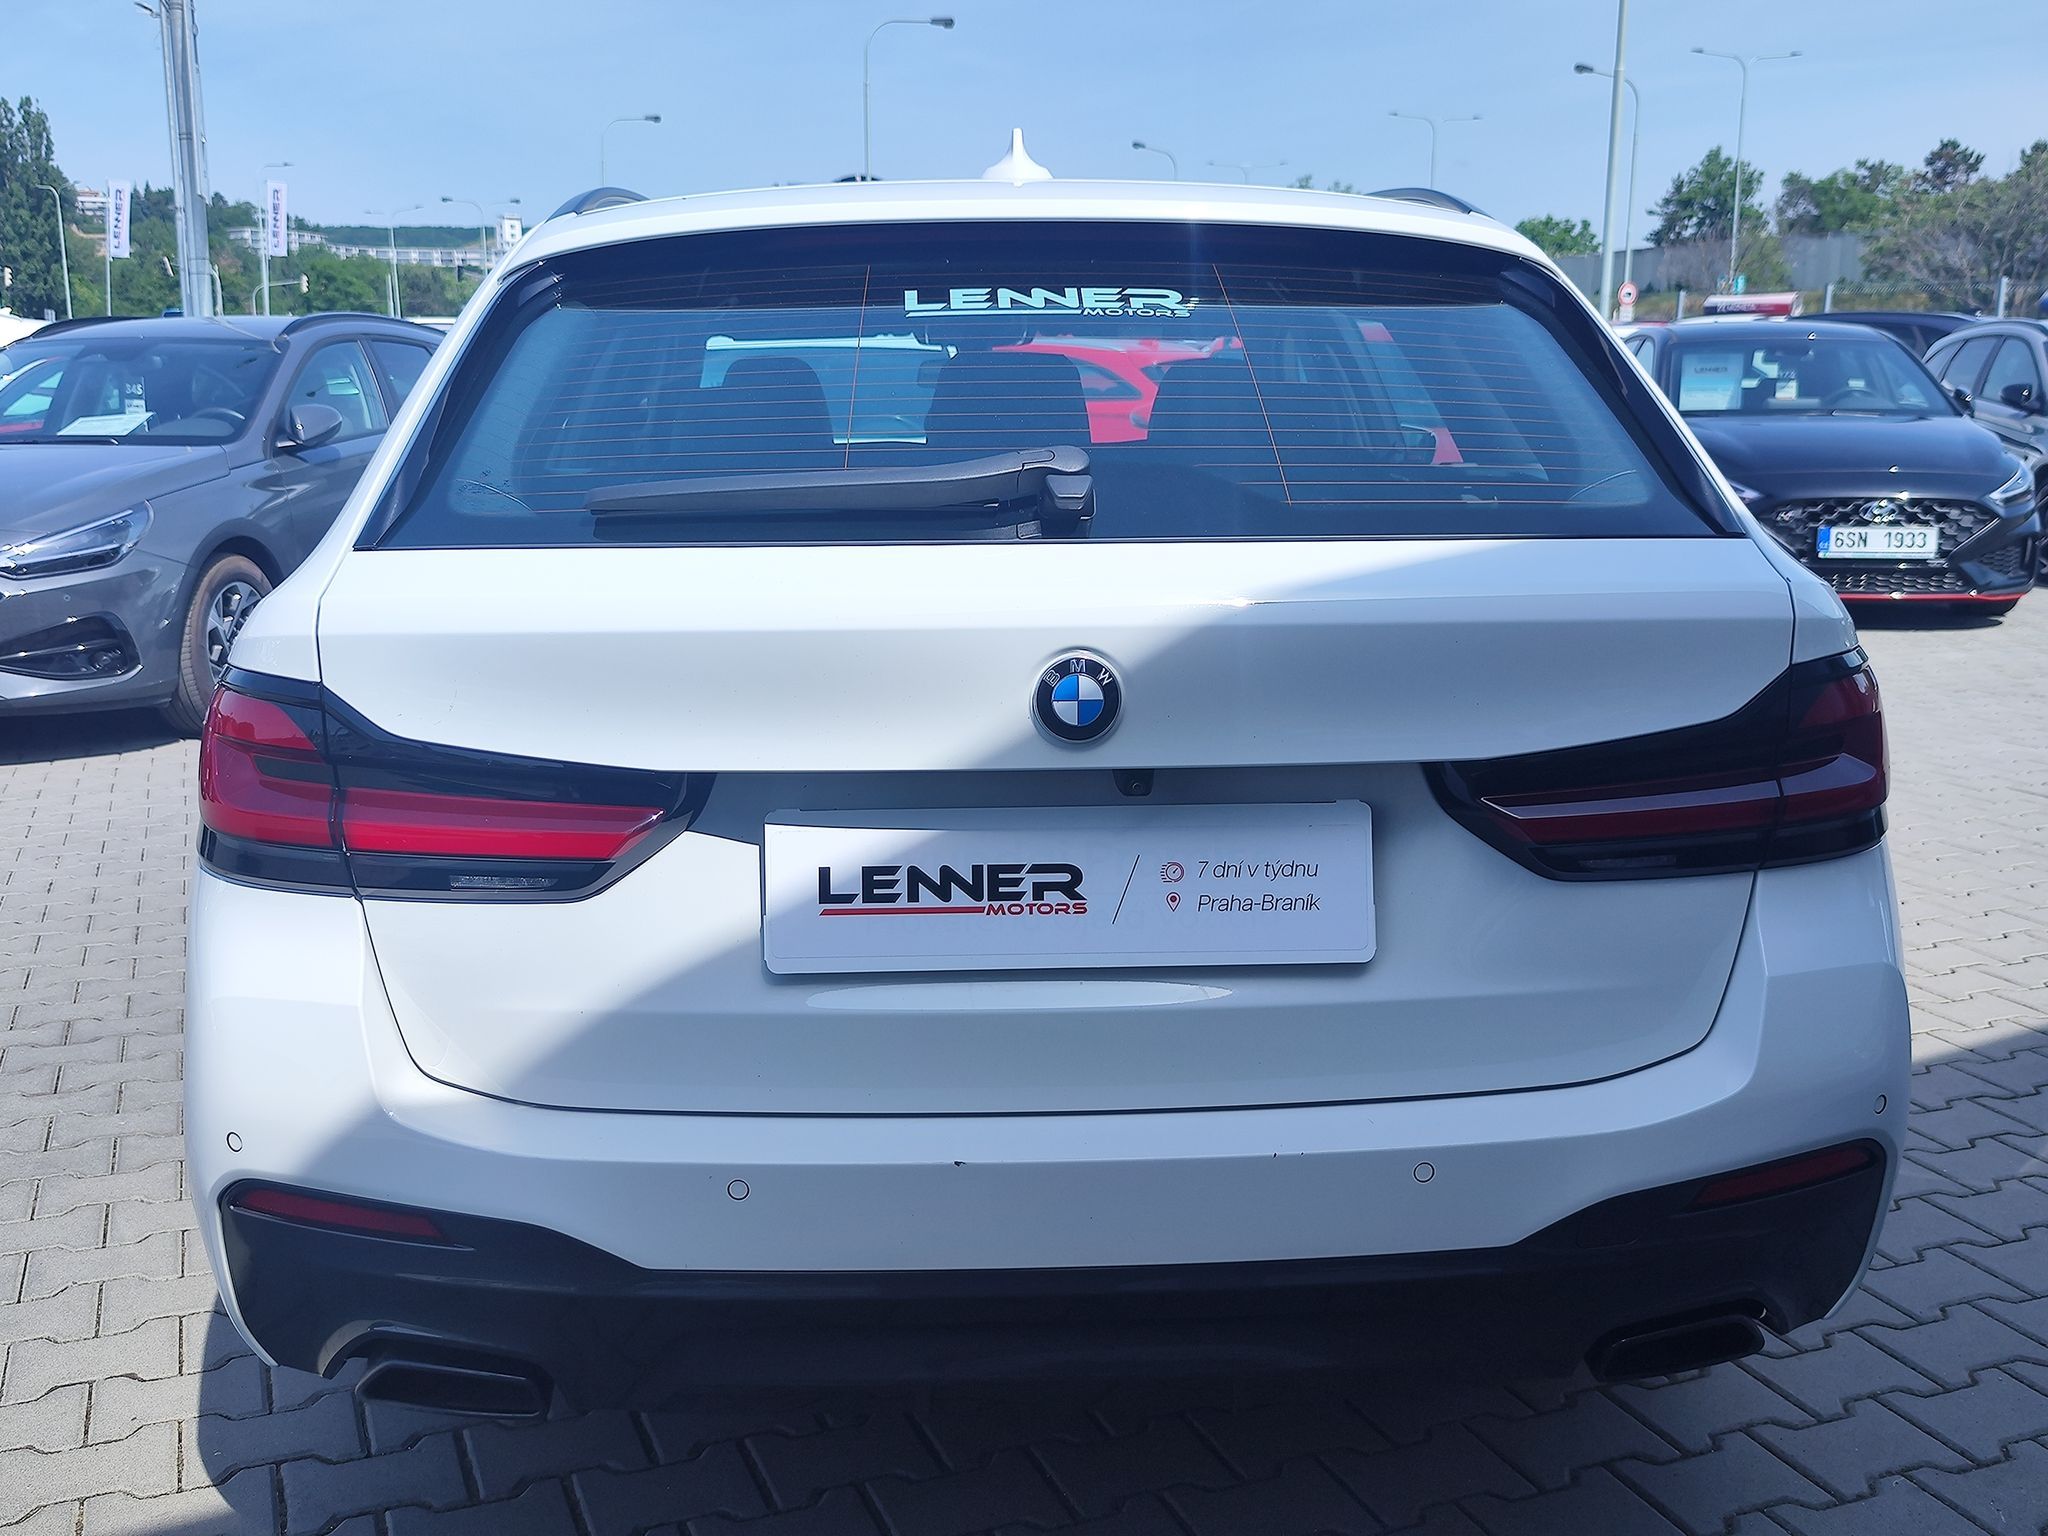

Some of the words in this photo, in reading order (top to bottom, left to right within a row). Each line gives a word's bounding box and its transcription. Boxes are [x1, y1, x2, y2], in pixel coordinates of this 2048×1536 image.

[904, 287, 1188, 311] LENNER
[1081, 308, 1191, 318] MOTORS
[1834, 531, 1868, 548] 6SN
[1883, 531, 1927, 548] 1933
[1043, 659, 1113, 687] BMW
[1198, 860, 1209, 878] 7
[1213, 860, 1244, 878] dní
[1247, 863, 1260, 878] v
[1265, 859, 1319, 882] týdnu
[818, 863, 1088, 904] LENNER
[985, 903, 1088, 916] MOTORS
[1197, 893, 1321, 912] Praha-Braník
